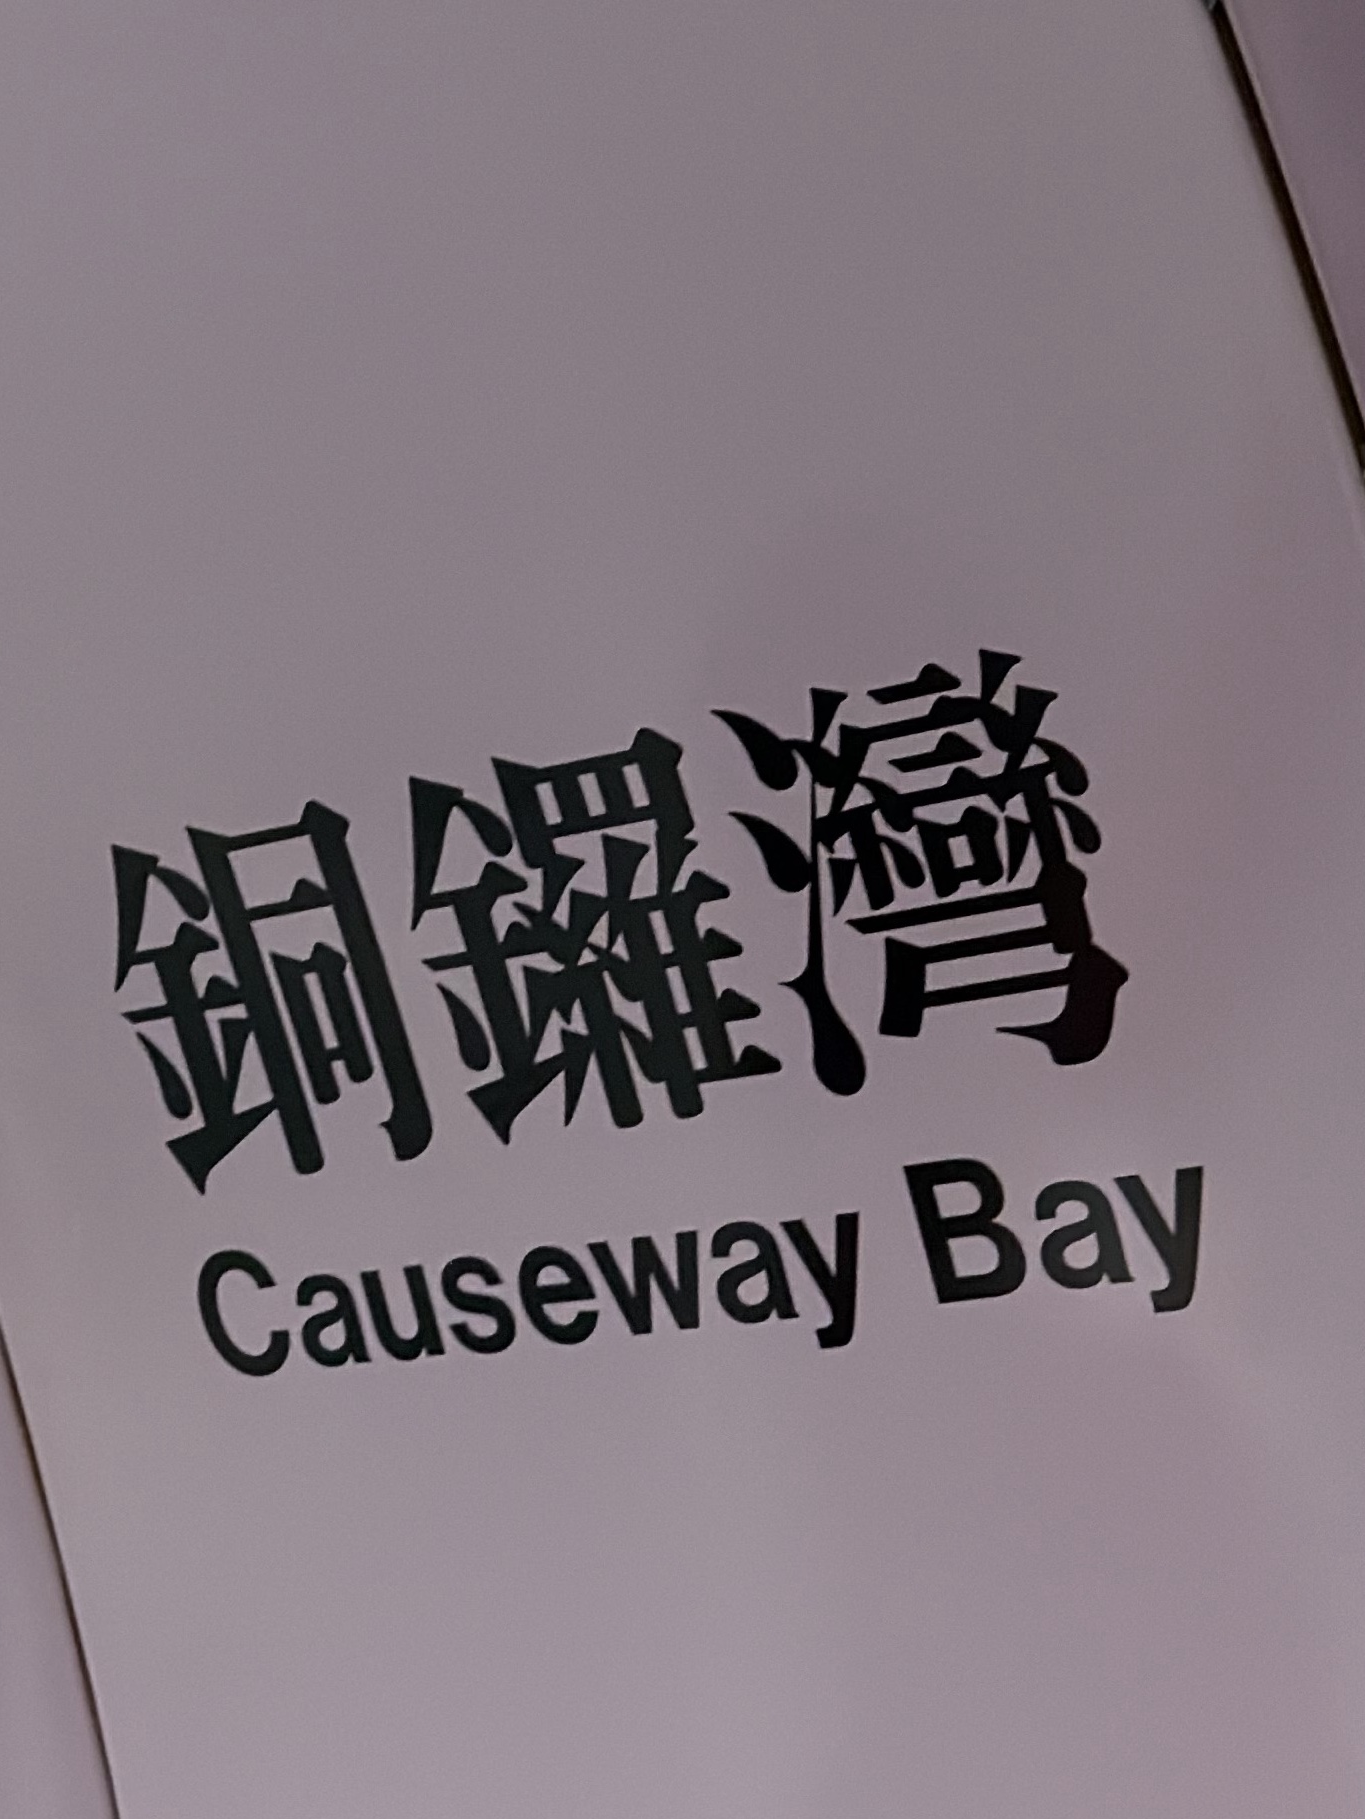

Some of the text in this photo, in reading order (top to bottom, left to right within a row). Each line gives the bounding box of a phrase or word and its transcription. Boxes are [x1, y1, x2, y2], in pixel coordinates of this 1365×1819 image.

[111, 649, 1129, 1195] 銅鑼灣
[197, 1158, 1204, 1377] Causeway Bay
